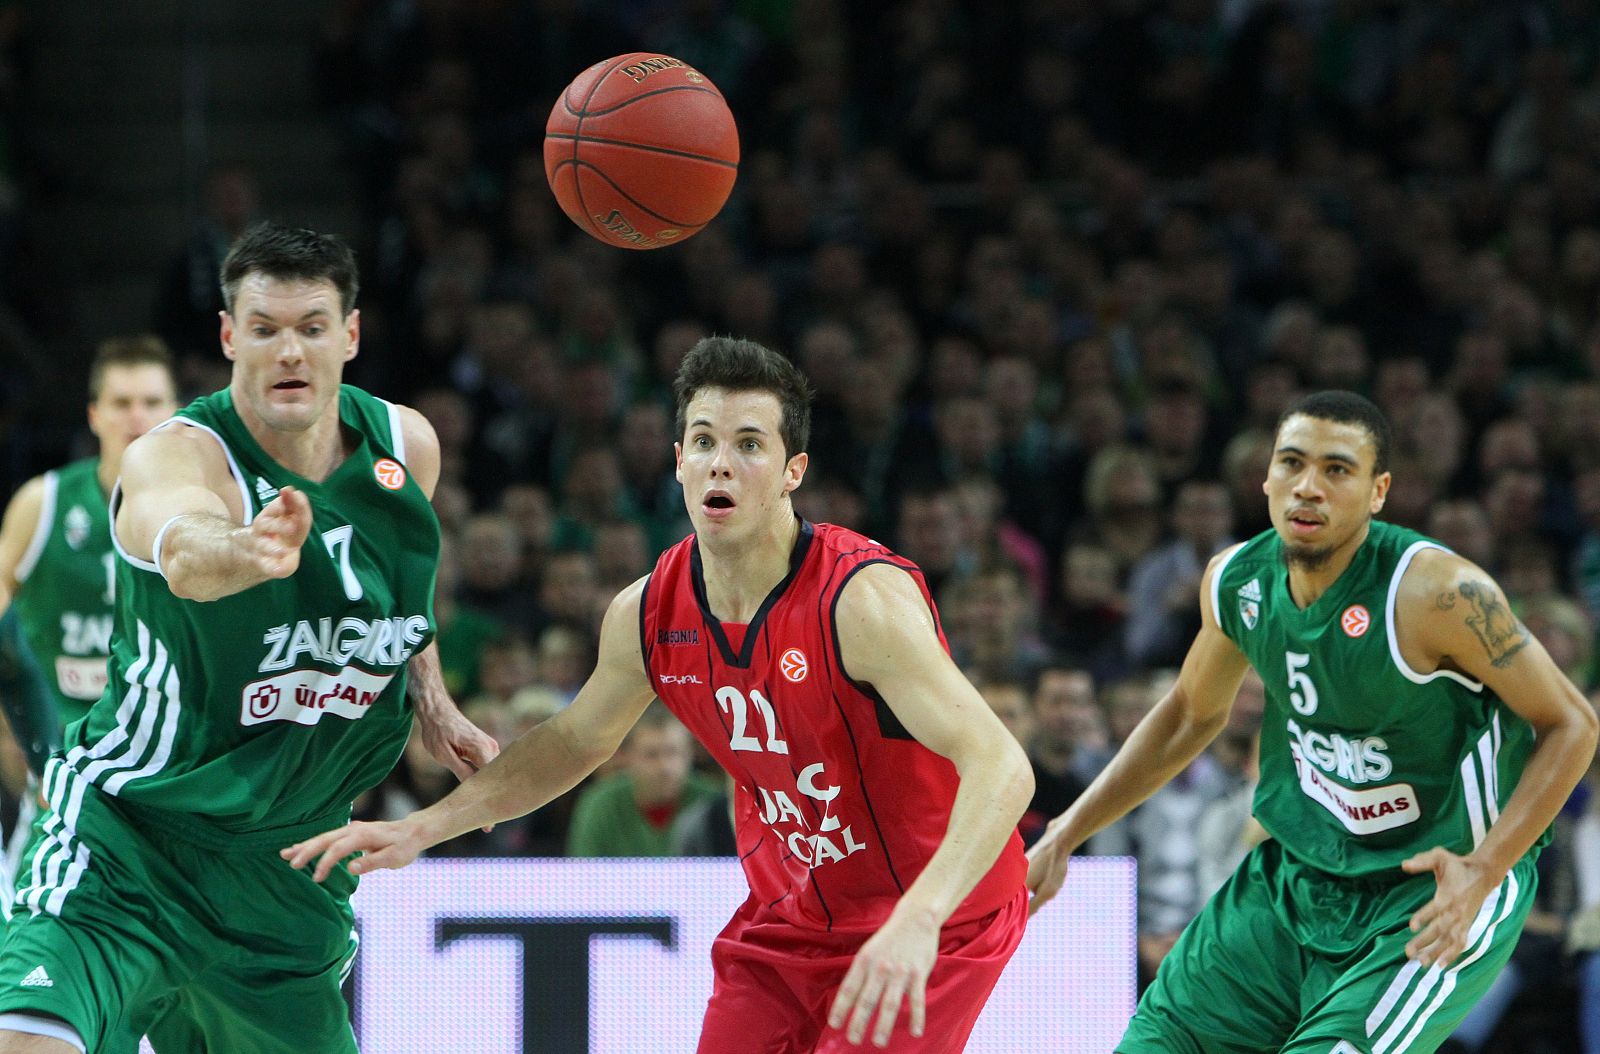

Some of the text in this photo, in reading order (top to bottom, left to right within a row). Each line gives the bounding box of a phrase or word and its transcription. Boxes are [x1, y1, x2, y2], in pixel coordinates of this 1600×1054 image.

[321, 524, 363, 601] 7
[1285, 650, 1319, 716] 5
[715, 685, 789, 755] 22
